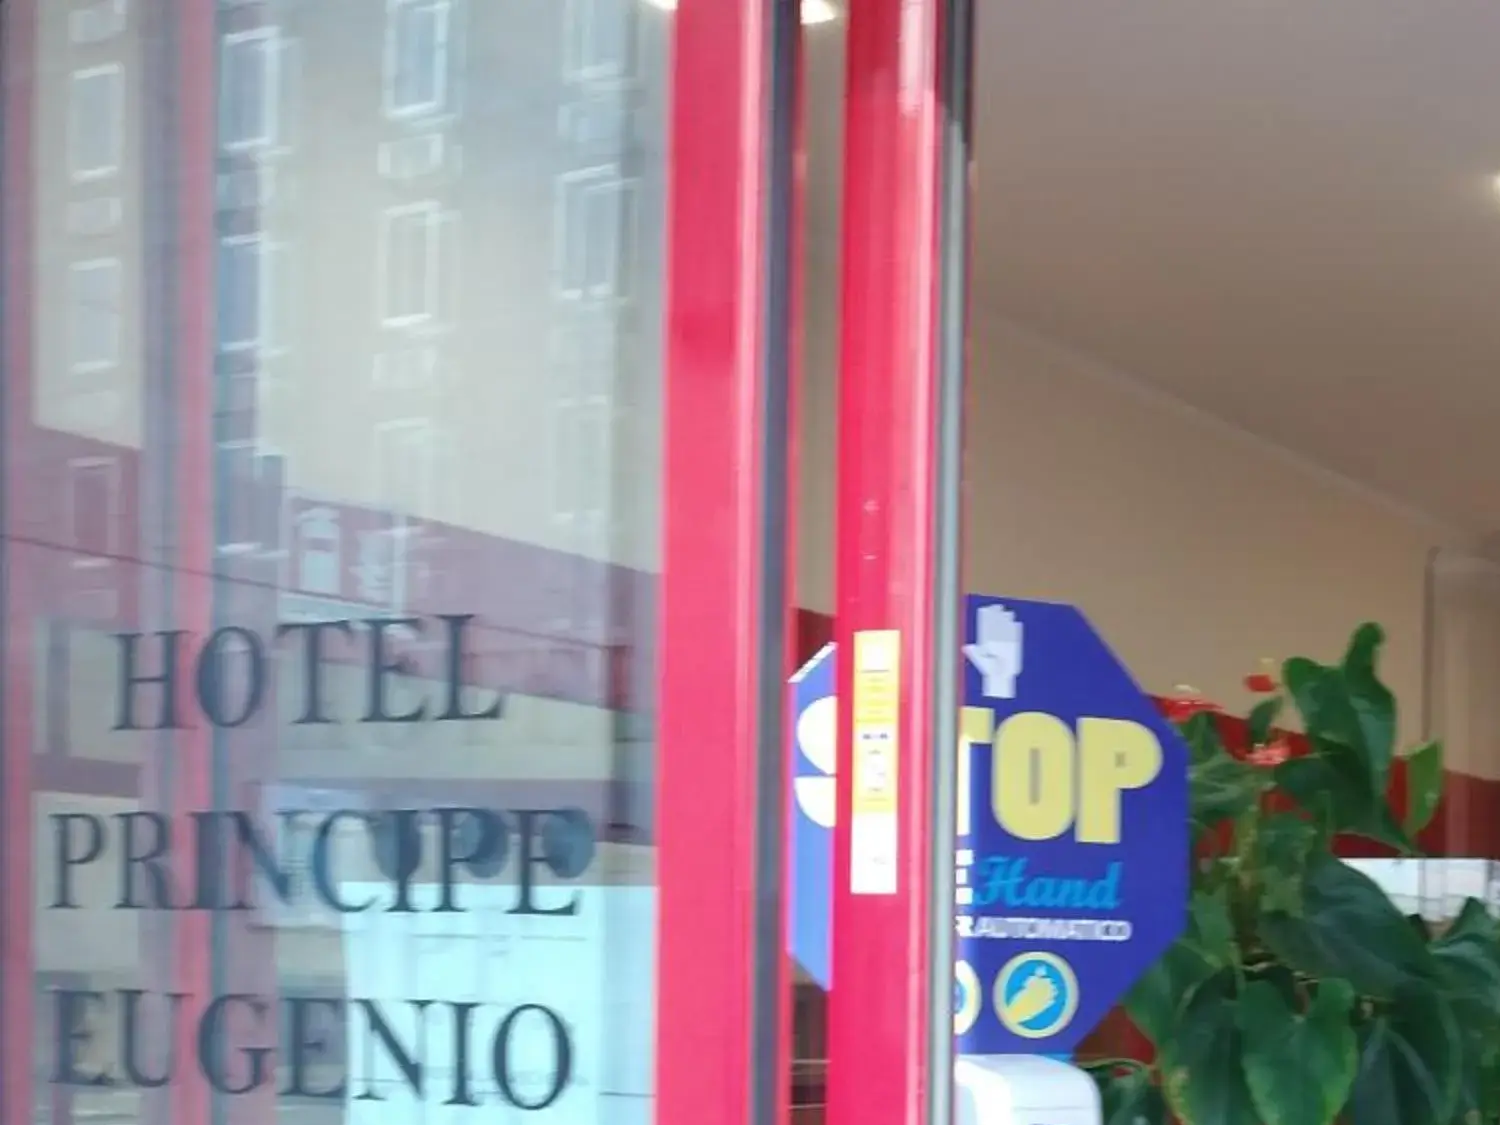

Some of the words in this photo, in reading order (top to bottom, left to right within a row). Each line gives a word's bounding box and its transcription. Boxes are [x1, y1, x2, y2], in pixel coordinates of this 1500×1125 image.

[110, 613, 504, 732] HOTEL
[47, 805, 585, 916] PRINCIPE
[972, 855, 1124, 909] Hand
[48, 988, 575, 1112] EUGENIO
